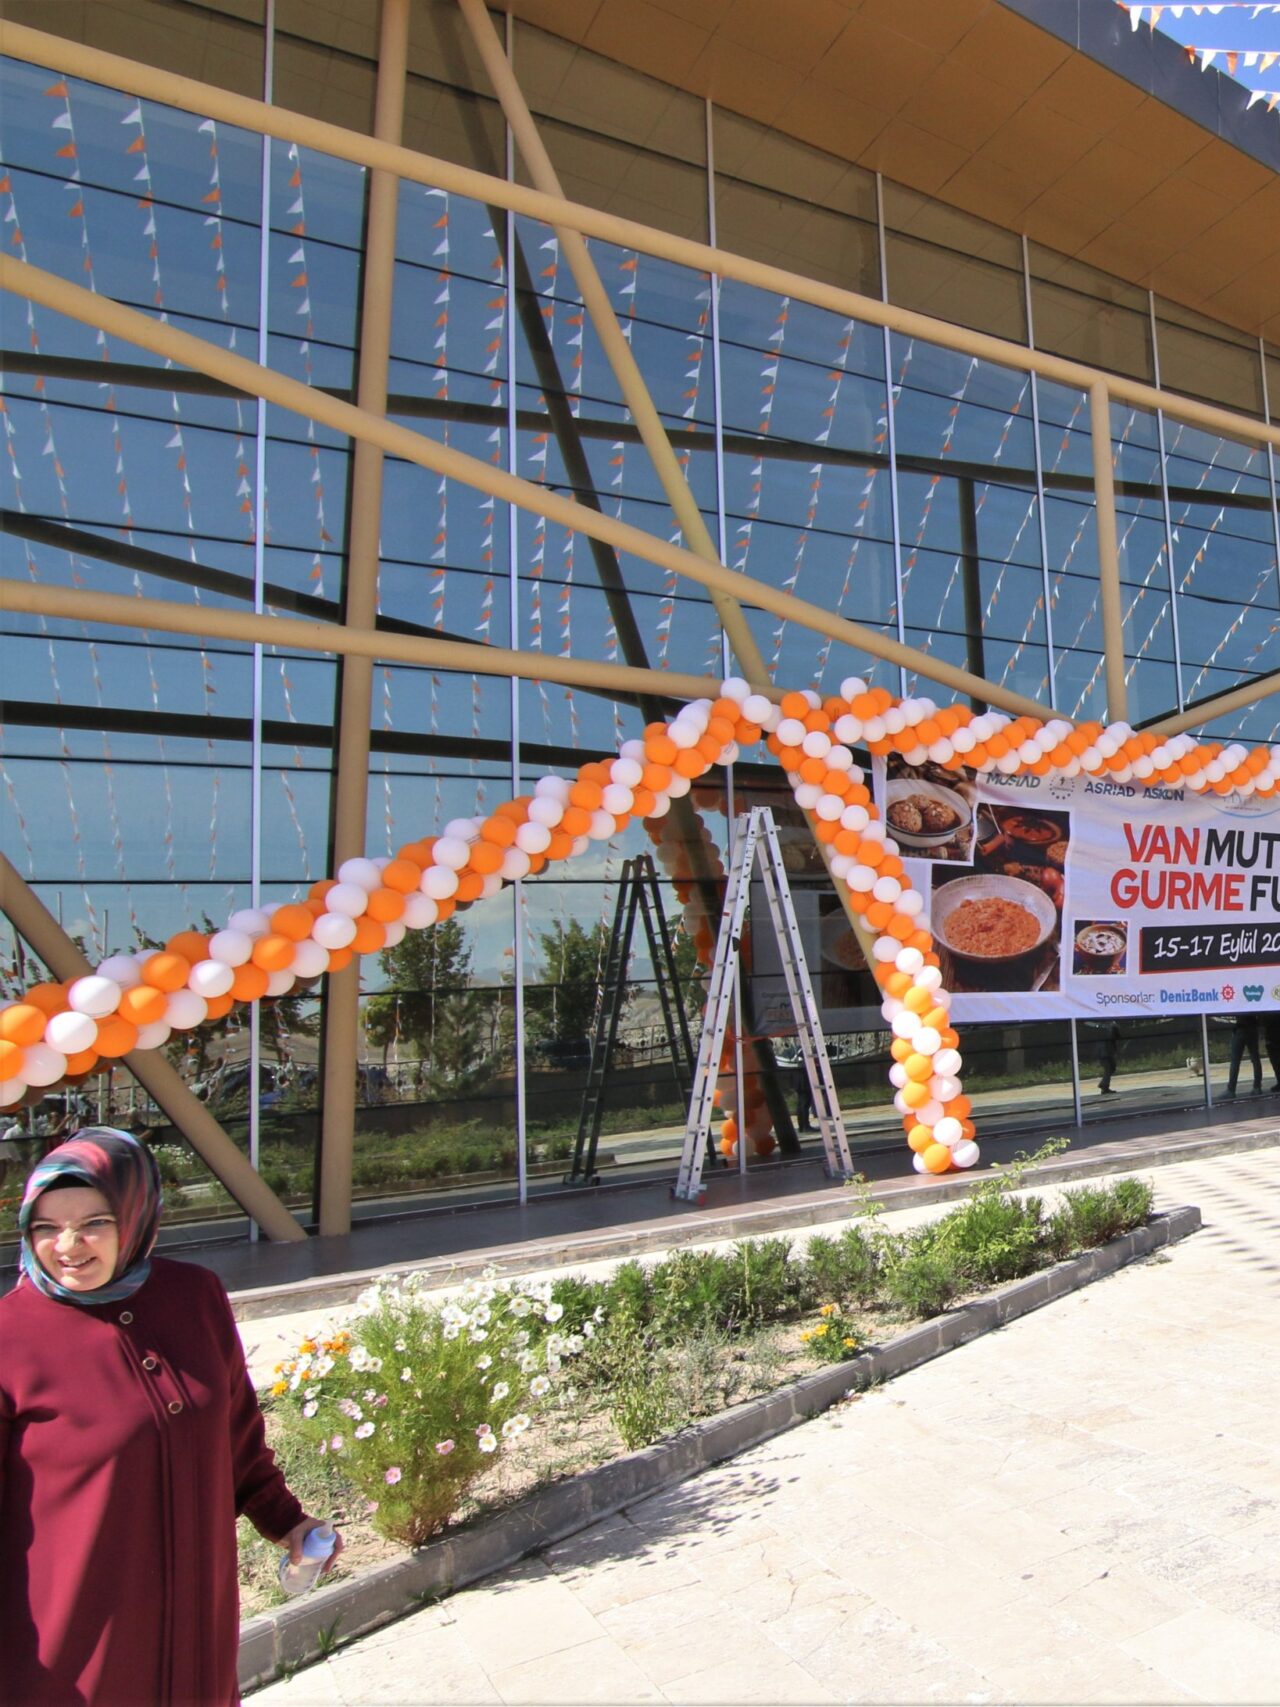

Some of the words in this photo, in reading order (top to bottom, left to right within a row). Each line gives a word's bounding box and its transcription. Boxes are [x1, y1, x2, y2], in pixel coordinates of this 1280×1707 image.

[1123, 822, 1200, 865] VAN
[1110, 868, 1245, 911] GURME
[1153, 936, 1214, 958] 15-17
[1219, 929, 1258, 962] Eylül
[1096, 991, 1155, 1007] Sponsorlar:
[1160, 988, 1219, 1003] DenizBank
